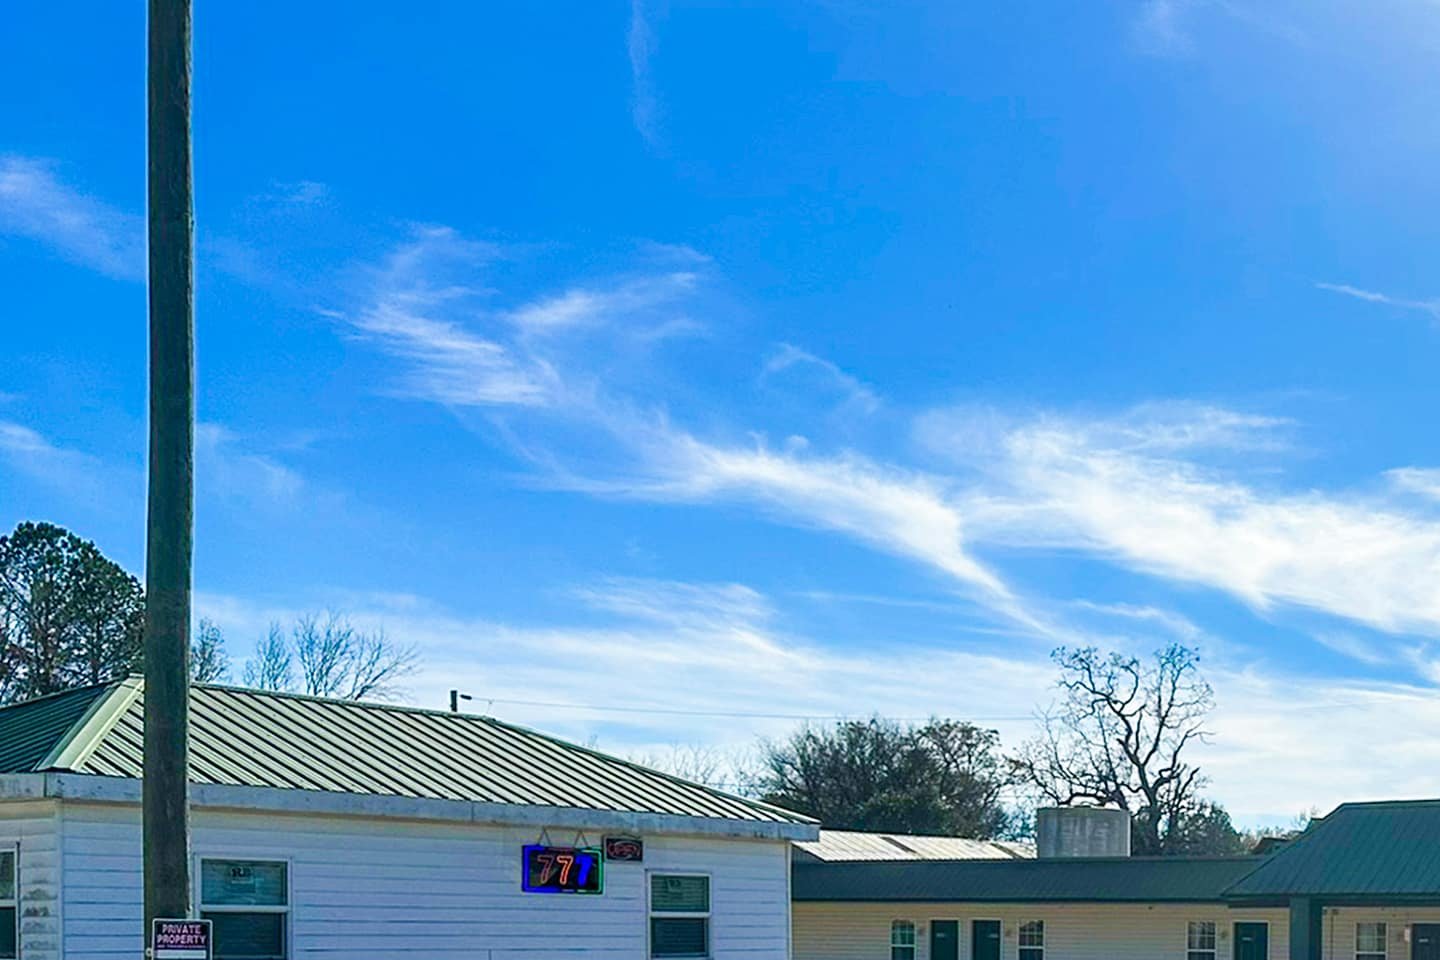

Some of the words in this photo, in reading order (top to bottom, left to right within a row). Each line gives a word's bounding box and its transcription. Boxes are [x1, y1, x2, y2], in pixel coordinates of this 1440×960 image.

[537, 854, 594, 887] 777
[162, 924, 202, 934] PRIVATE
[157, 934, 206, 944] PROPERTY
